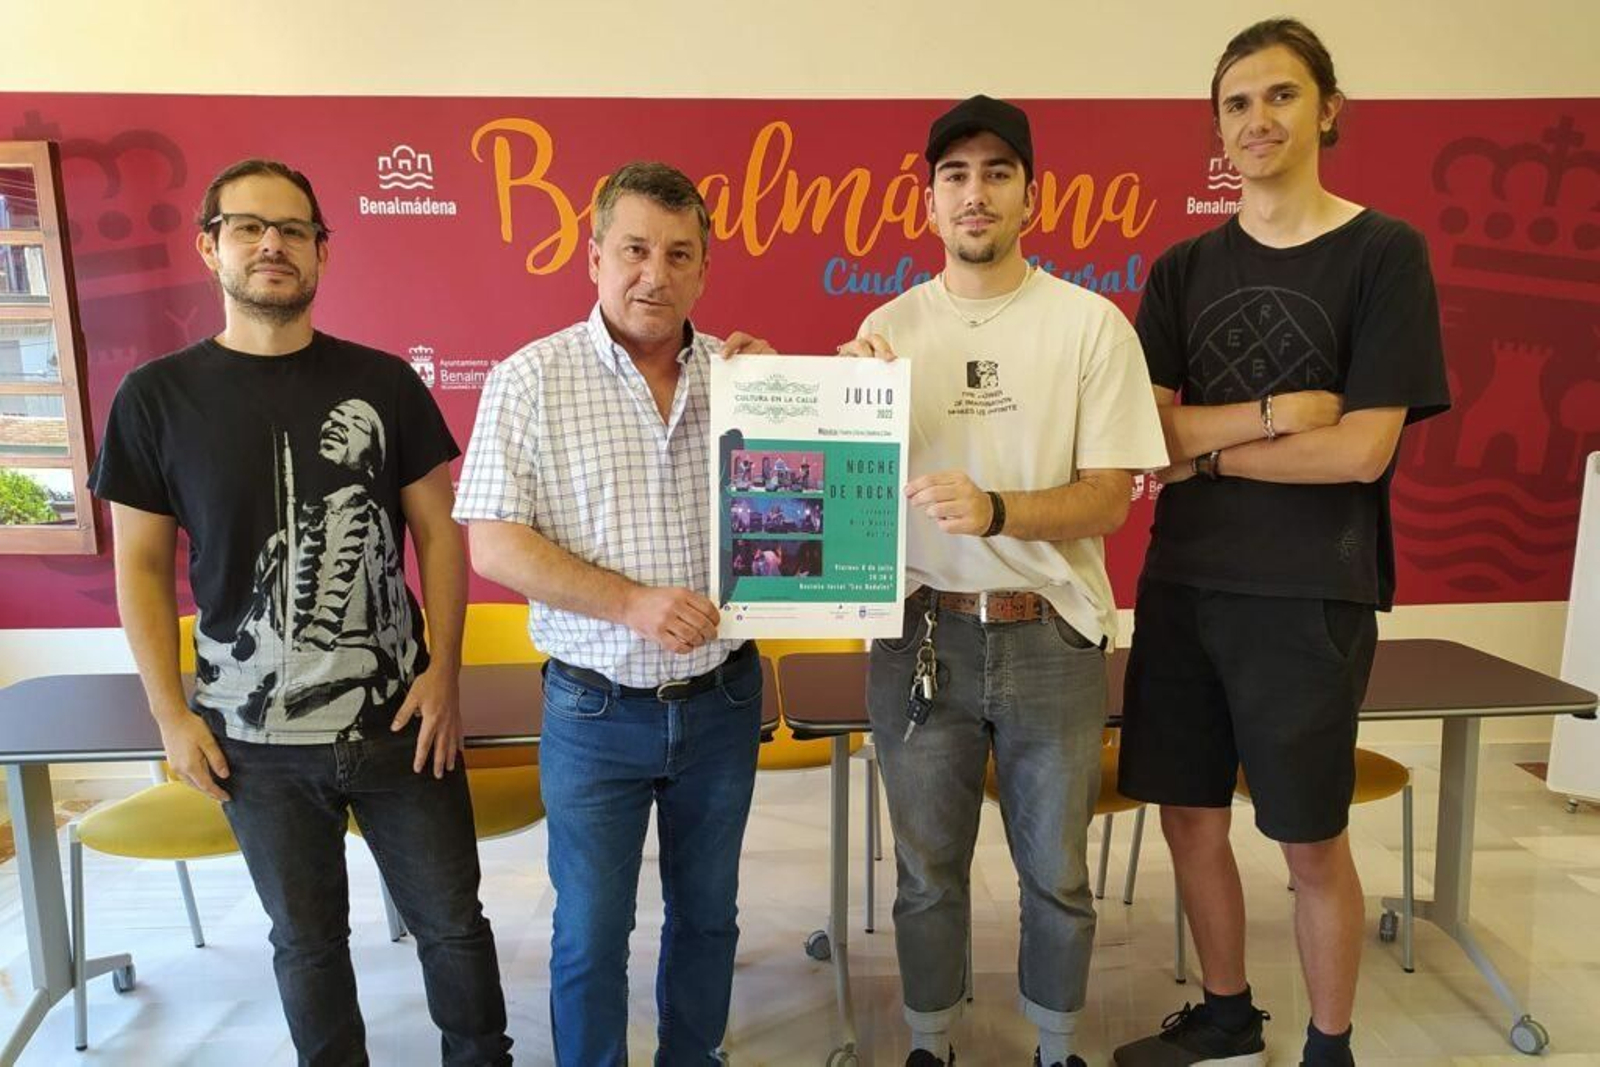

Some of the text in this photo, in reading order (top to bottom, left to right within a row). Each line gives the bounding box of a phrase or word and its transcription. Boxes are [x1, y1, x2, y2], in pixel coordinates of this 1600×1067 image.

[471, 117, 1157, 275] Balmána
[359, 196, 457, 215] Benalmádena
[1186, 196, 1243, 214] Benalm
[440, 359, 488, 368] Ayuntamiento
[440, 368, 486, 382] Benalm
[845, 387, 893, 405] JULIO
[847, 459, 894, 475] NOCHE
[830, 485, 894, 500] DE ROCK
